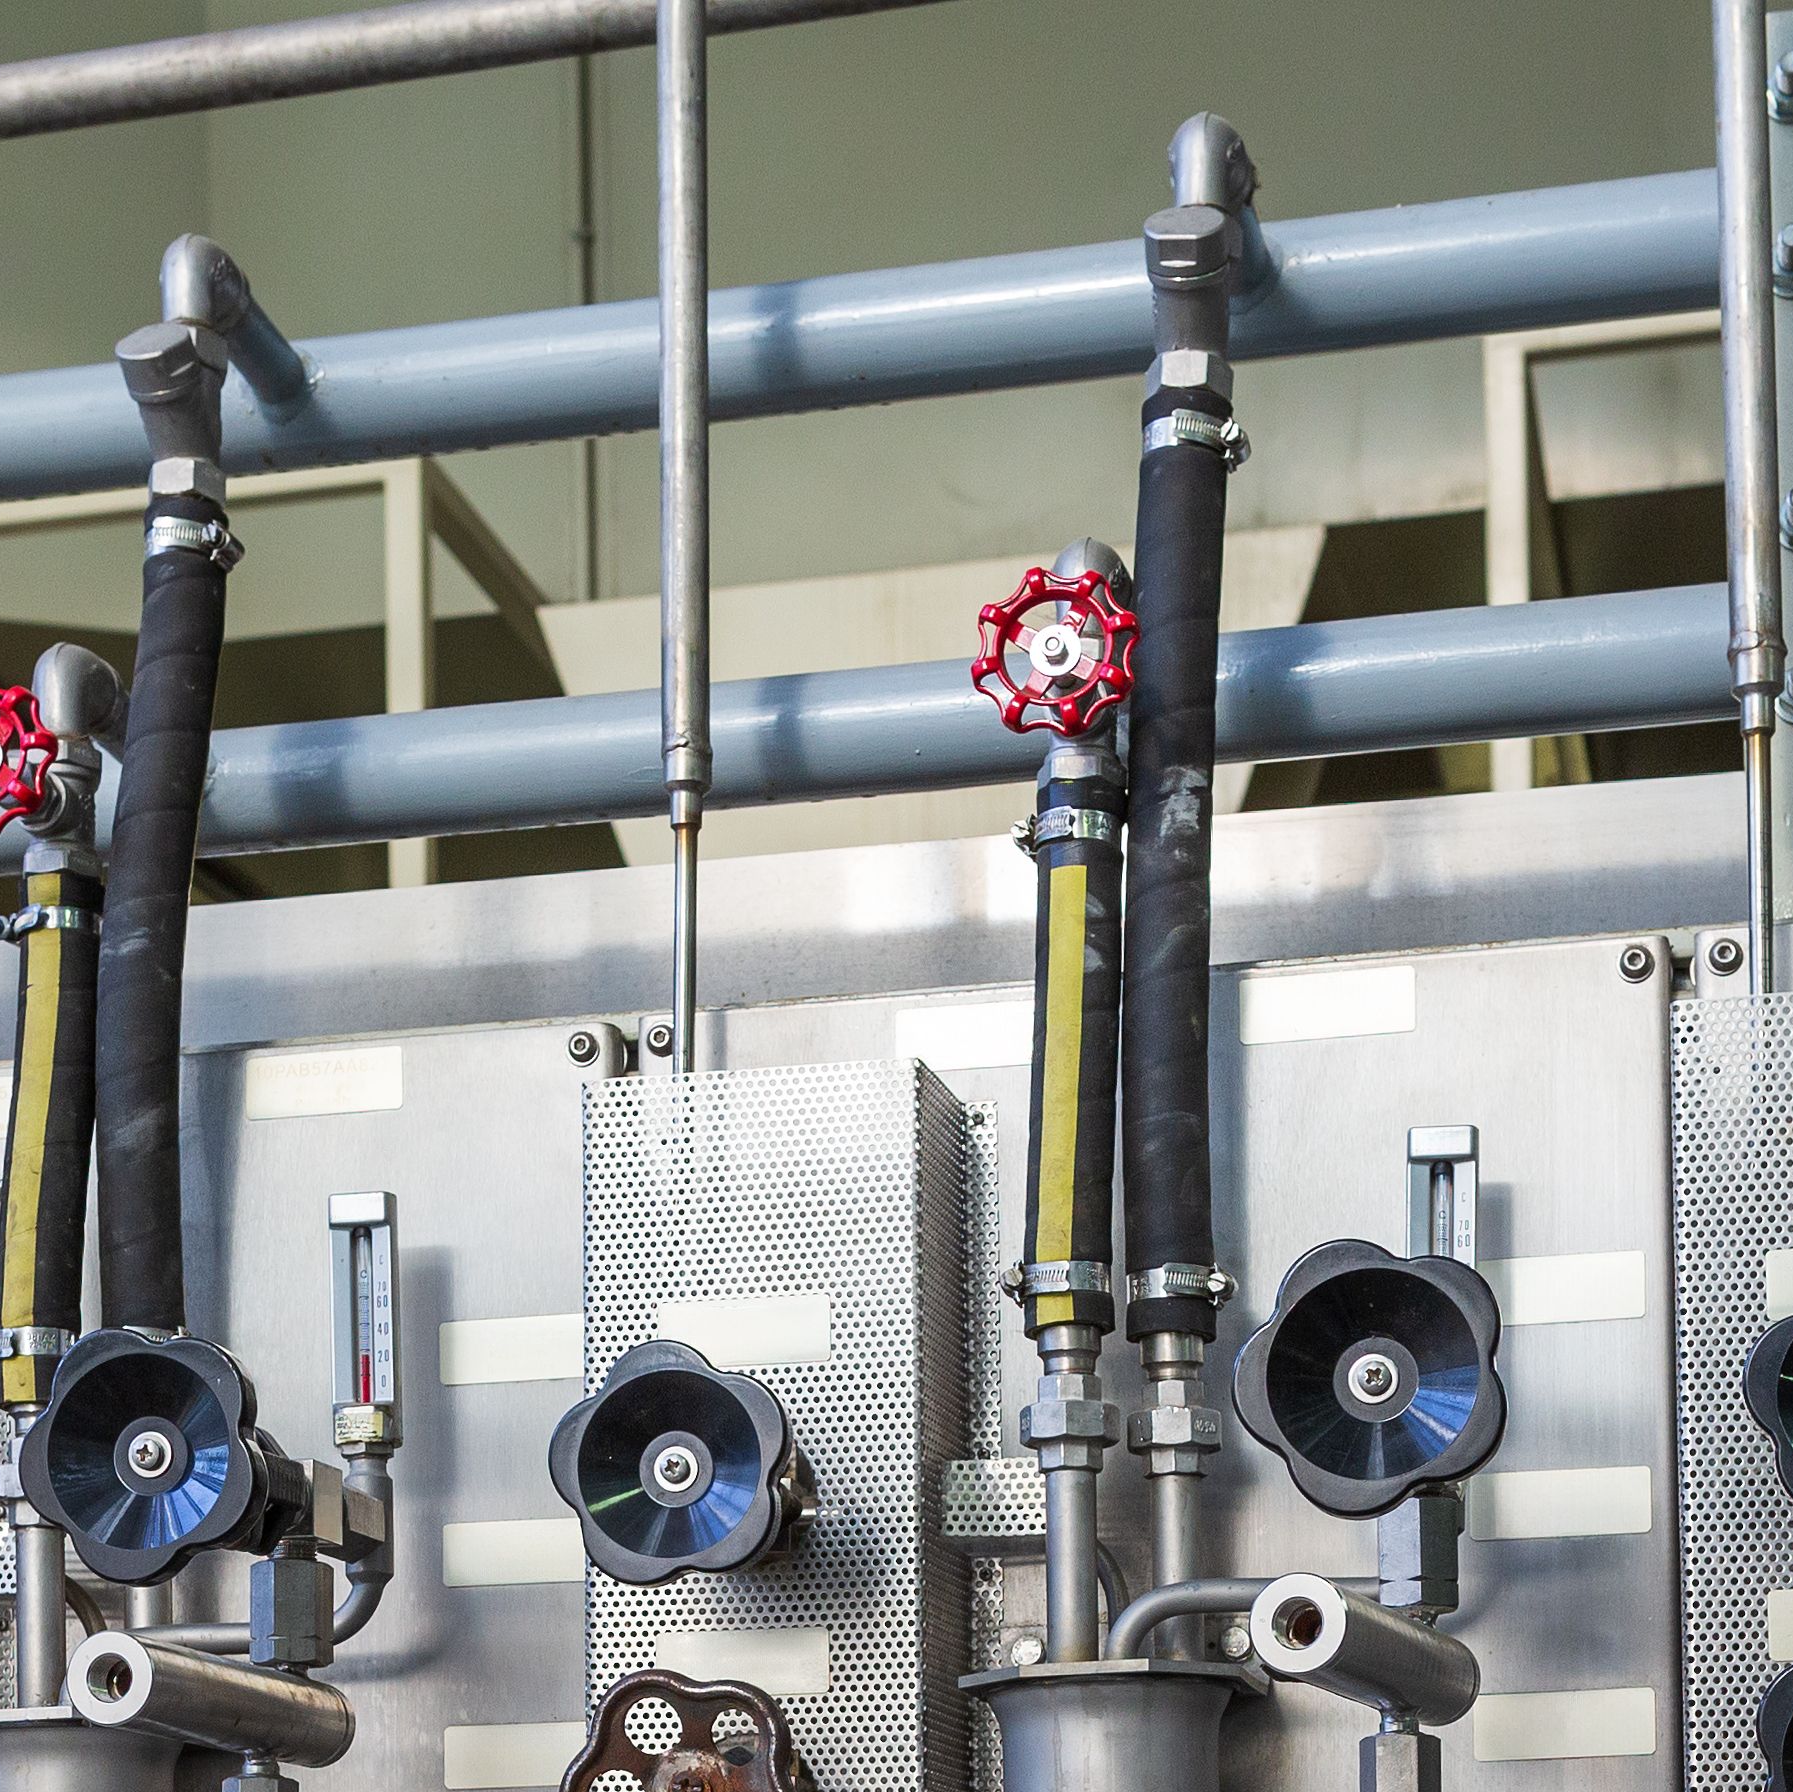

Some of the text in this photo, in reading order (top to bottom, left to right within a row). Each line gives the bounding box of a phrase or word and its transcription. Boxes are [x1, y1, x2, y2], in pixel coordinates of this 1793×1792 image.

[1439, 1210, 1446, 1219] C
[1459, 1220, 1469, 1230] 70
[1458, 1234, 1470, 1247] 60
[360, 1270, 367, 1279] C
[377, 1282, 386, 1292] 70
[377, 1295, 388, 1307] 60
[377, 1323, 388, 1335] 40
[378, 1351, 389, 1363] 20
[382, 1375, 386, 1387] 0
